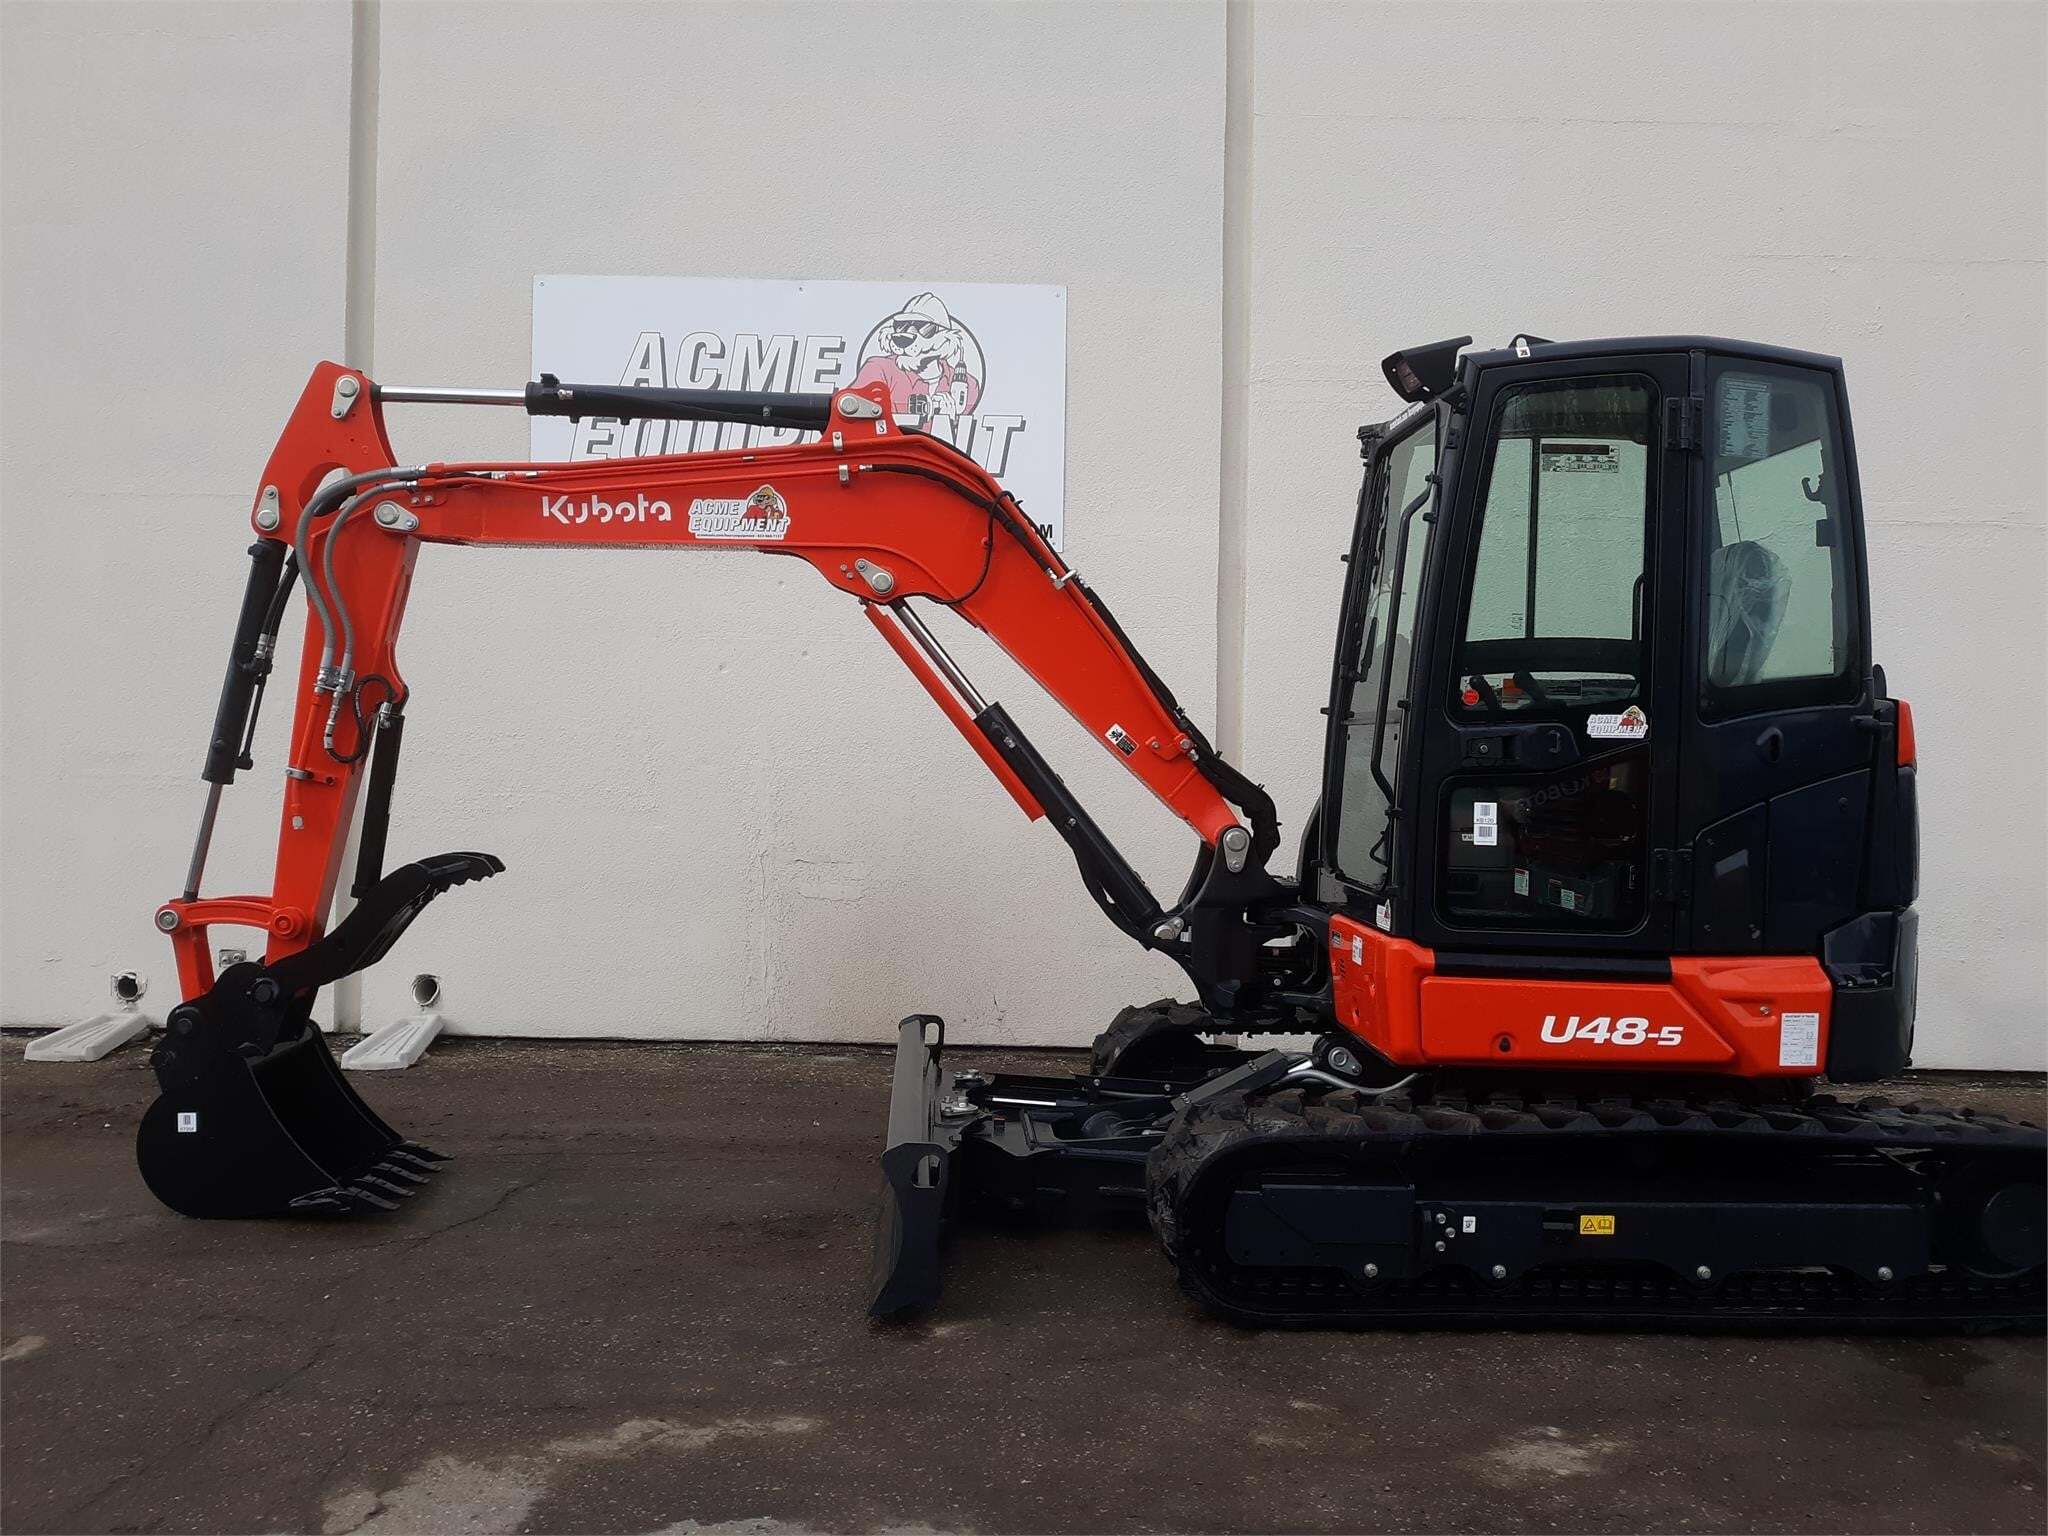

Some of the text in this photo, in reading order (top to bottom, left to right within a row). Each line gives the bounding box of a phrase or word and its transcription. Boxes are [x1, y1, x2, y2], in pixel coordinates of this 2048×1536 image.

[618, 331, 847, 394] ACME
[542, 493, 672, 525] Kubota
[692, 500, 740, 516] ACME
[691, 516, 789, 533] EQUIPMENT
[1588, 714, 1619, 725] ACME
[1588, 725, 1647, 735] EQUIPMENT
[1540, 1015, 1684, 1046] U48-5
